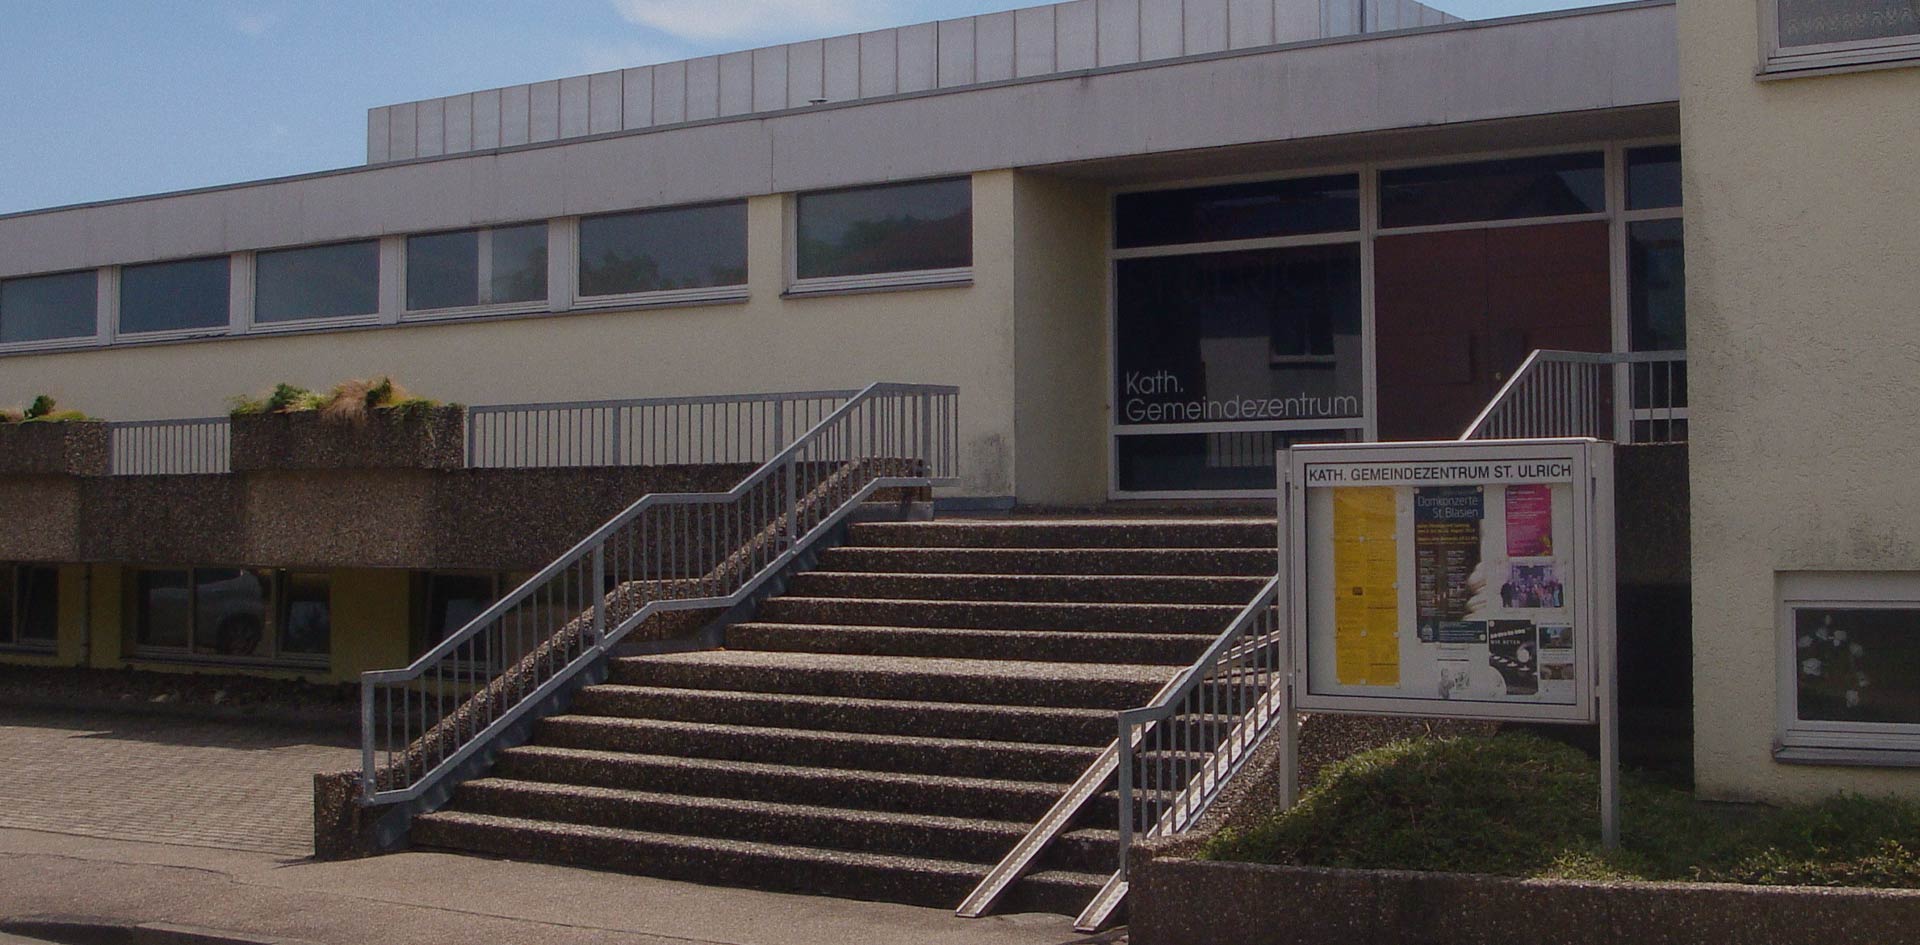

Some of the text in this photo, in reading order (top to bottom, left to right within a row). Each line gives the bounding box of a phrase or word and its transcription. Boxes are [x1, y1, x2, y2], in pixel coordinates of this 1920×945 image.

[1126, 370, 1184, 395] Kath.
[1126, 392, 1358, 422] Gemeindezentrum
[1309, 464, 1571, 481] KATH. GEMEINDEZENTRUM ST. ULRICH
[1417, 496, 1478, 507] Domkonzerte
[1445, 507, 1479, 518] Blasien
